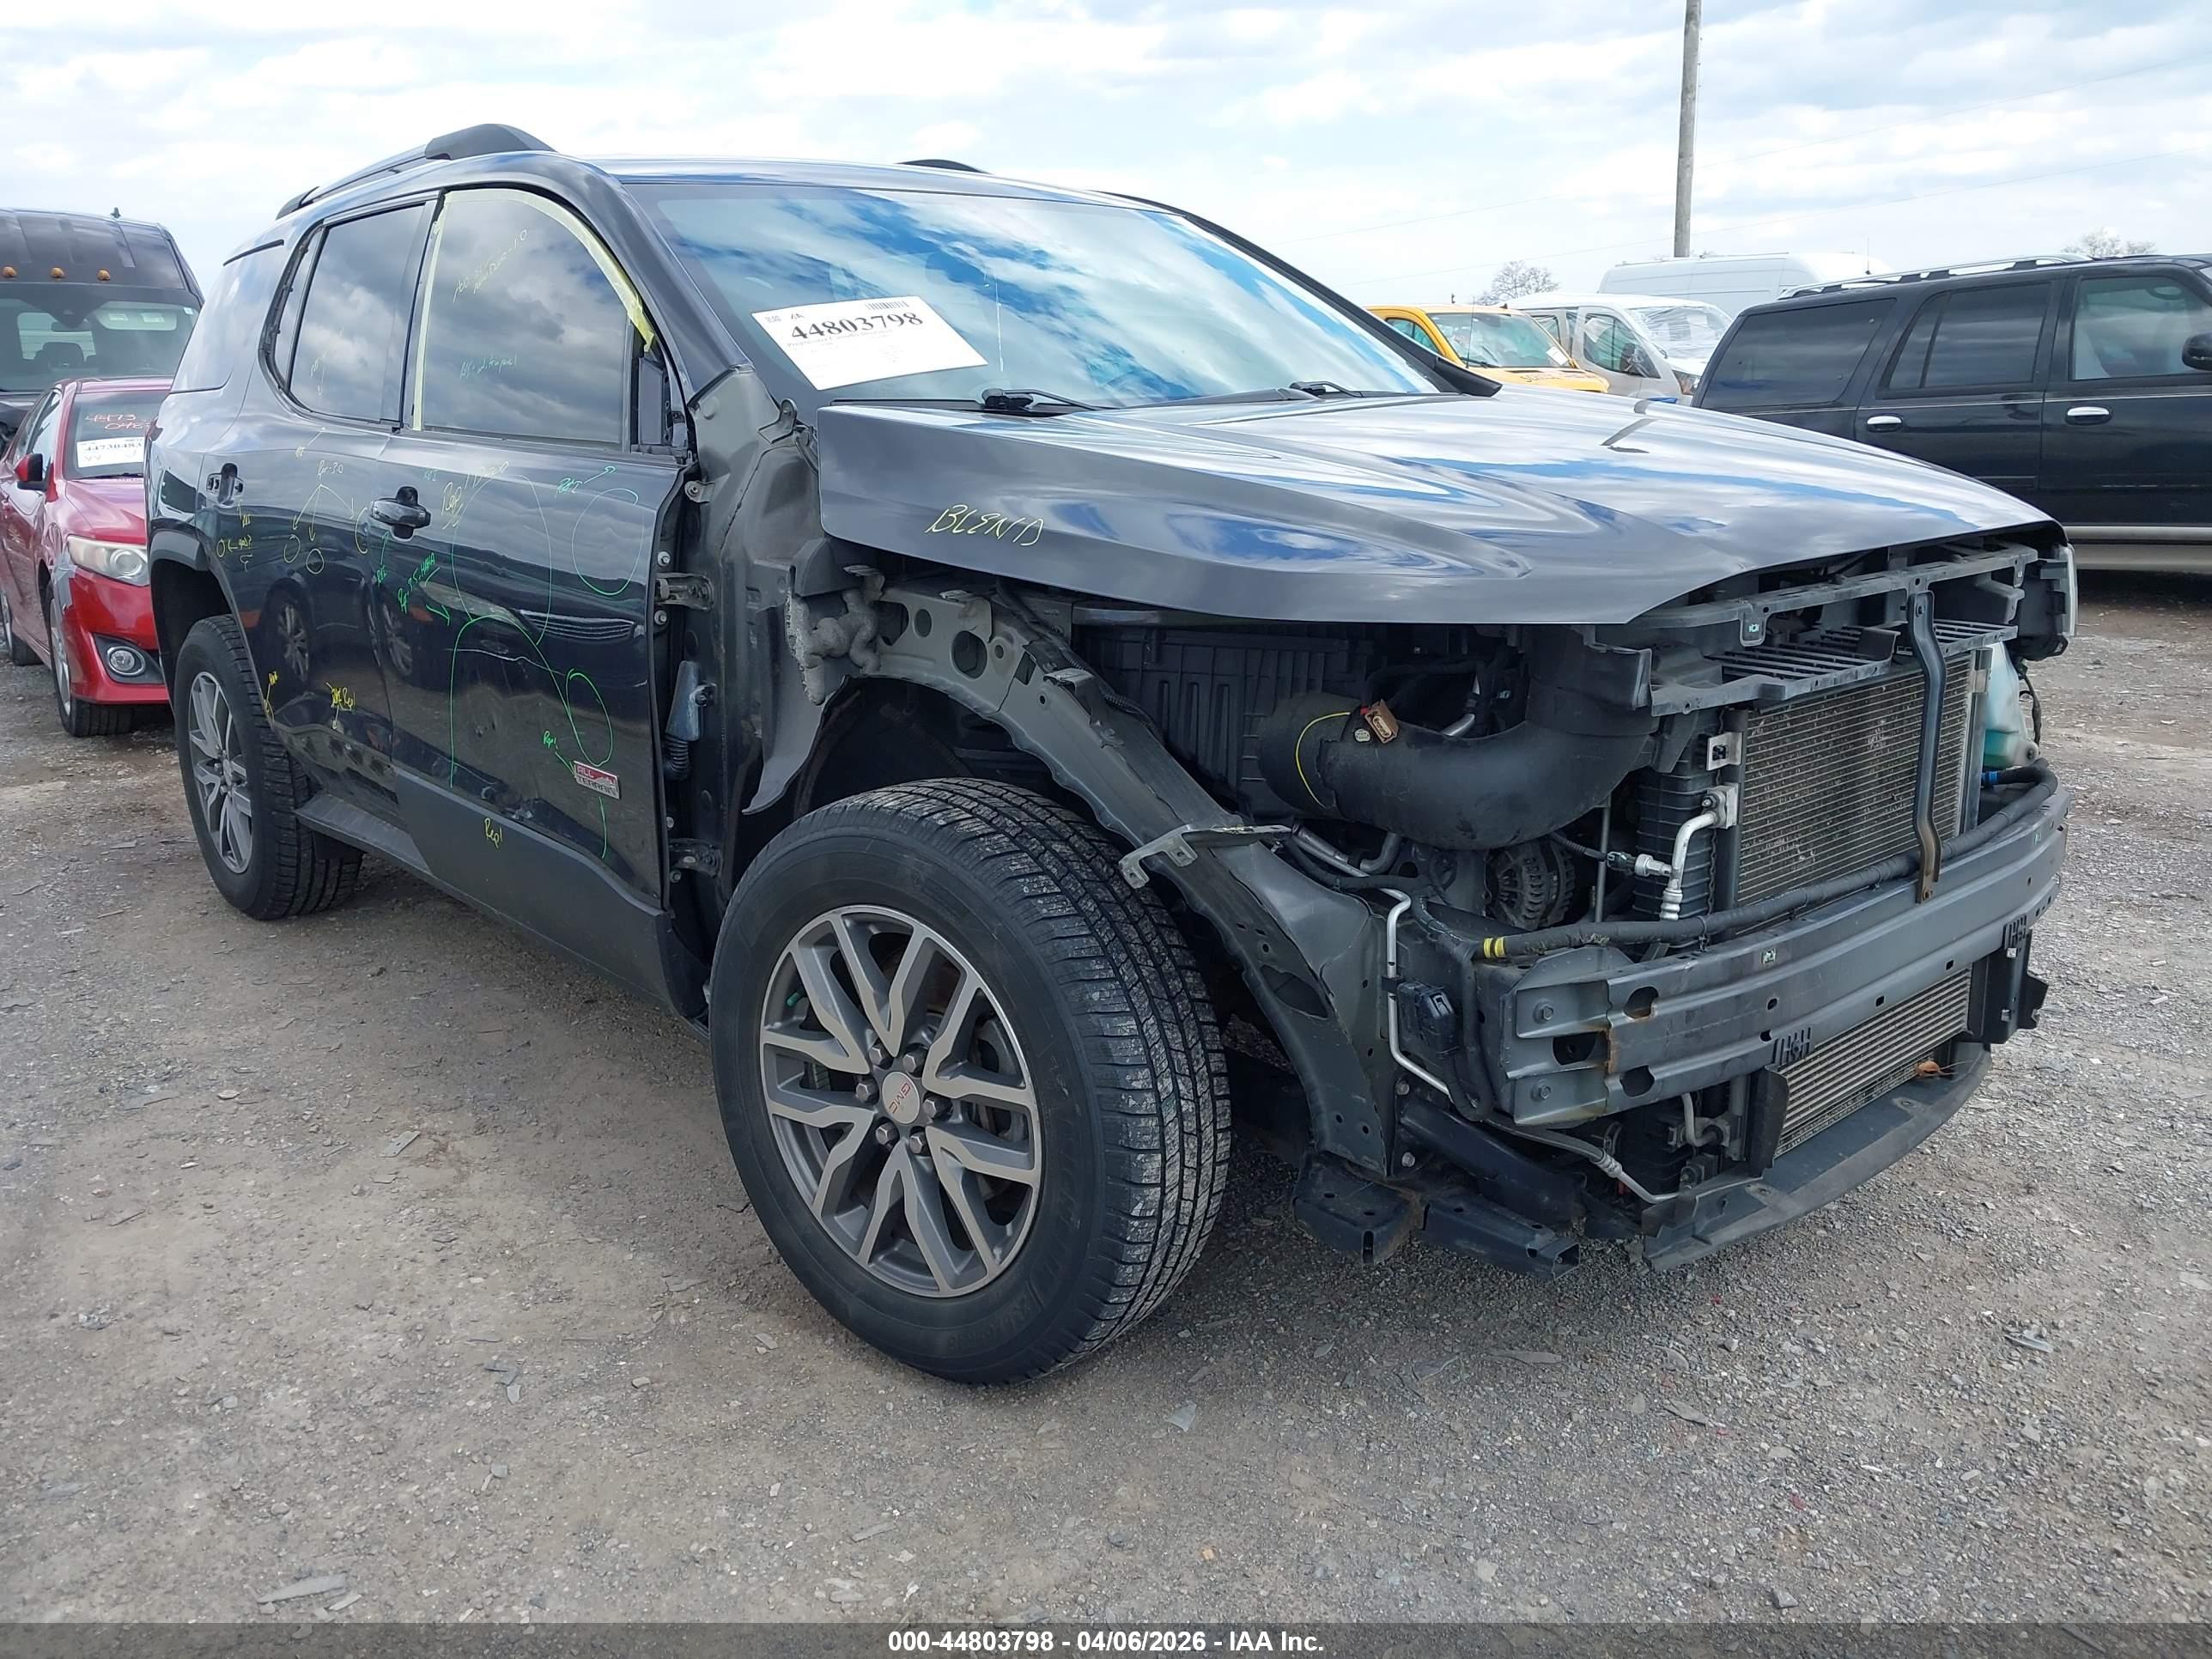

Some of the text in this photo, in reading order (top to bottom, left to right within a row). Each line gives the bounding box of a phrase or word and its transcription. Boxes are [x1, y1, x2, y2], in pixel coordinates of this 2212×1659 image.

[791, 312, 924, 340] 44803798
[924, 504, 1044, 546] BLEND
[888, 1082, 911, 1114] GMC
